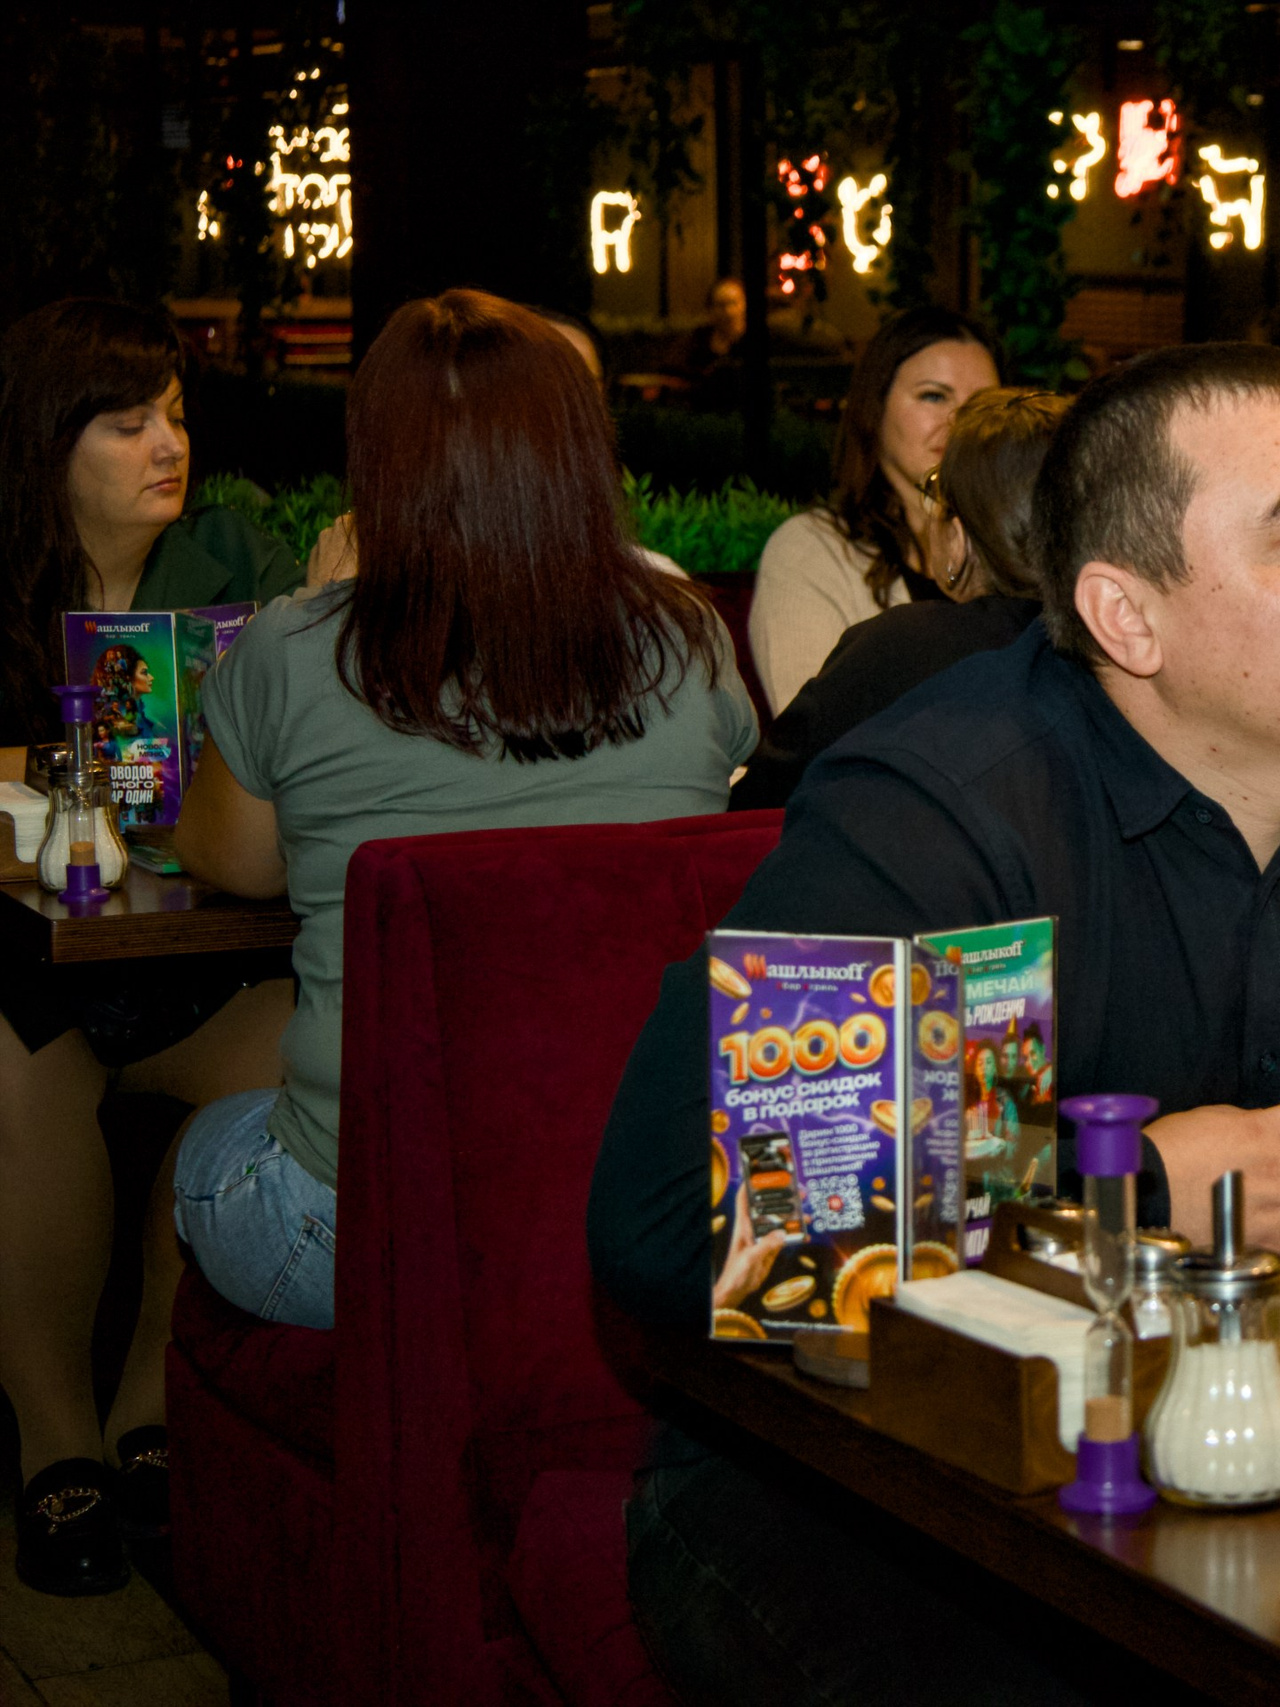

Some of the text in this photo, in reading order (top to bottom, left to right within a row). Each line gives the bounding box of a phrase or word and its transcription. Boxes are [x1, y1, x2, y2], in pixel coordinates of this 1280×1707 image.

[110, 765, 154, 781] ОВОДОВ
[125, 790, 154, 805] ОДИН
[966, 970, 1034, 999] МЕЧАЙ
[719, 1012, 887, 1086] 1000
[725, 1071, 882, 1108] бонус скидок
[743, 1092, 861, 1122] в подарок
